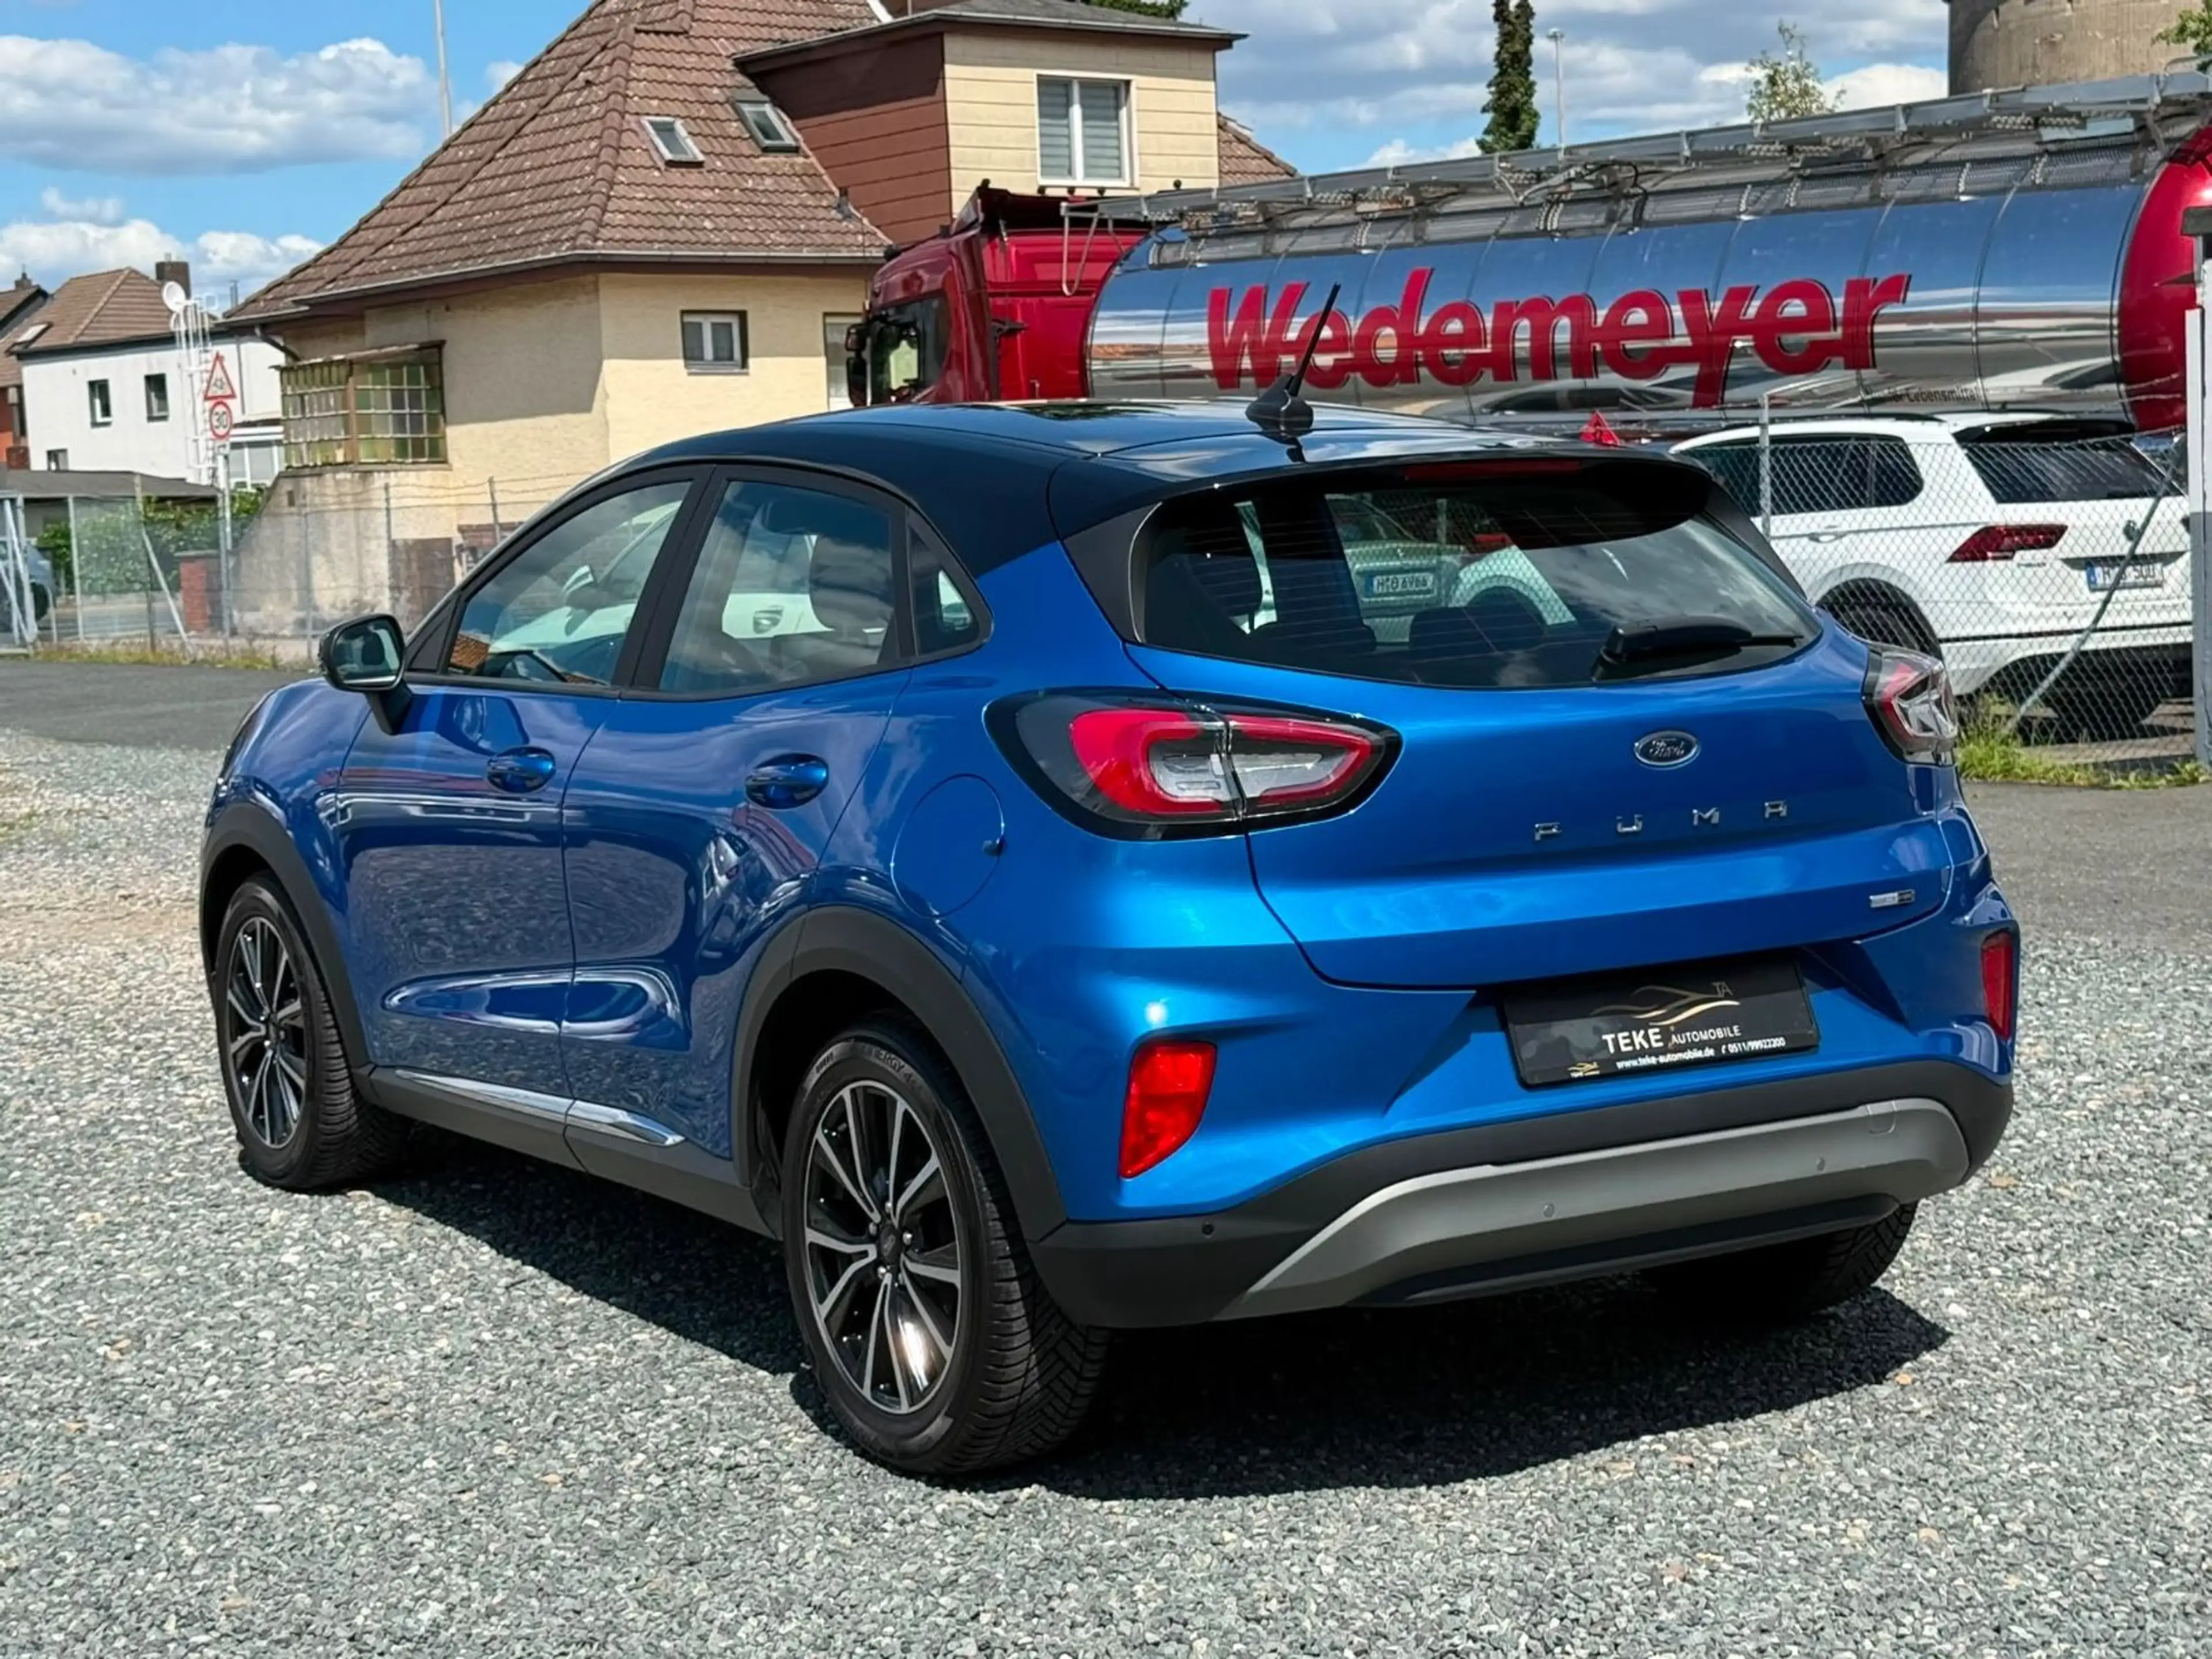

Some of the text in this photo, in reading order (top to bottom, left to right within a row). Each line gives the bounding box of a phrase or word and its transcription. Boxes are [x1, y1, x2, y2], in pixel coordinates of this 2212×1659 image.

[1207, 266, 1912, 407] Wedemeyer
[215, 411, 227, 429] 30
[1535, 800, 1787, 840] PUMA
[1602, 1025, 1742, 1054] TEKE AUTOMOBILE
